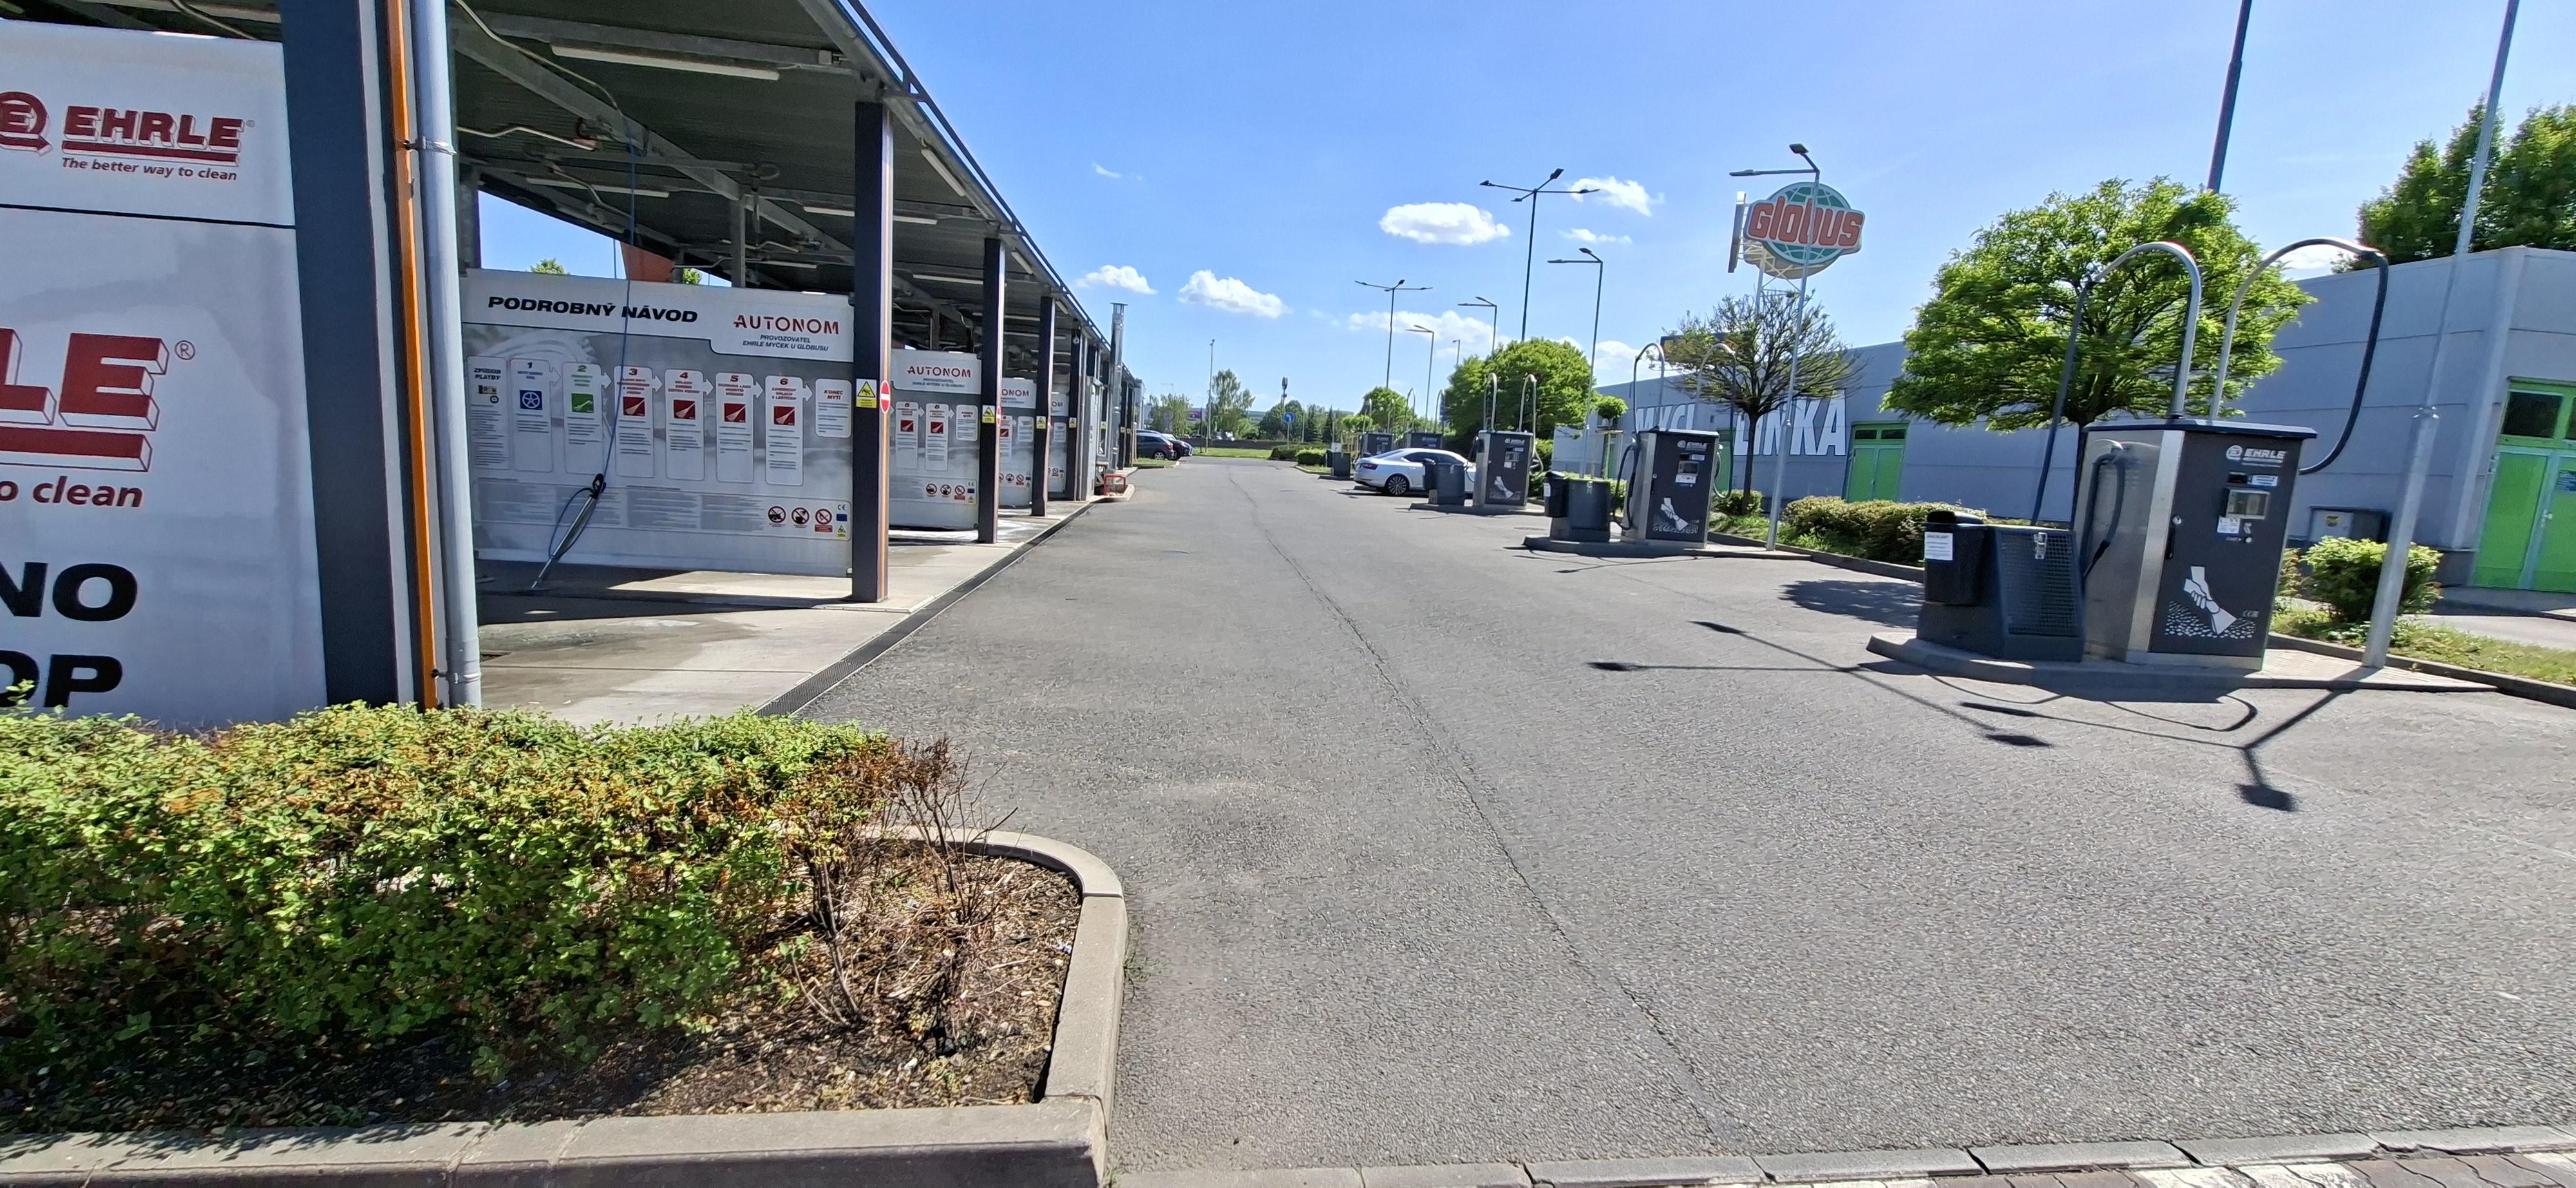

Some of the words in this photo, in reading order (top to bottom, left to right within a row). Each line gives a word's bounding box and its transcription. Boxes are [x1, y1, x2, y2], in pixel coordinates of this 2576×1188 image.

[62, 157, 88, 169] The
[92, 158, 138, 174] better
[143, 165, 173, 178] way
[178, 166, 194, 178] to
[197, 168, 238, 181] clean
[487, 296, 616, 317] PODROBNÝ
[621, 305, 698, 323] NÁVOD
[733, 314, 839, 335] AUTONOM
[760, 334, 811, 343] PROVOZOVATEL
[907, 365, 971, 378] AUTONOM
[32, 475, 144, 508] clean
